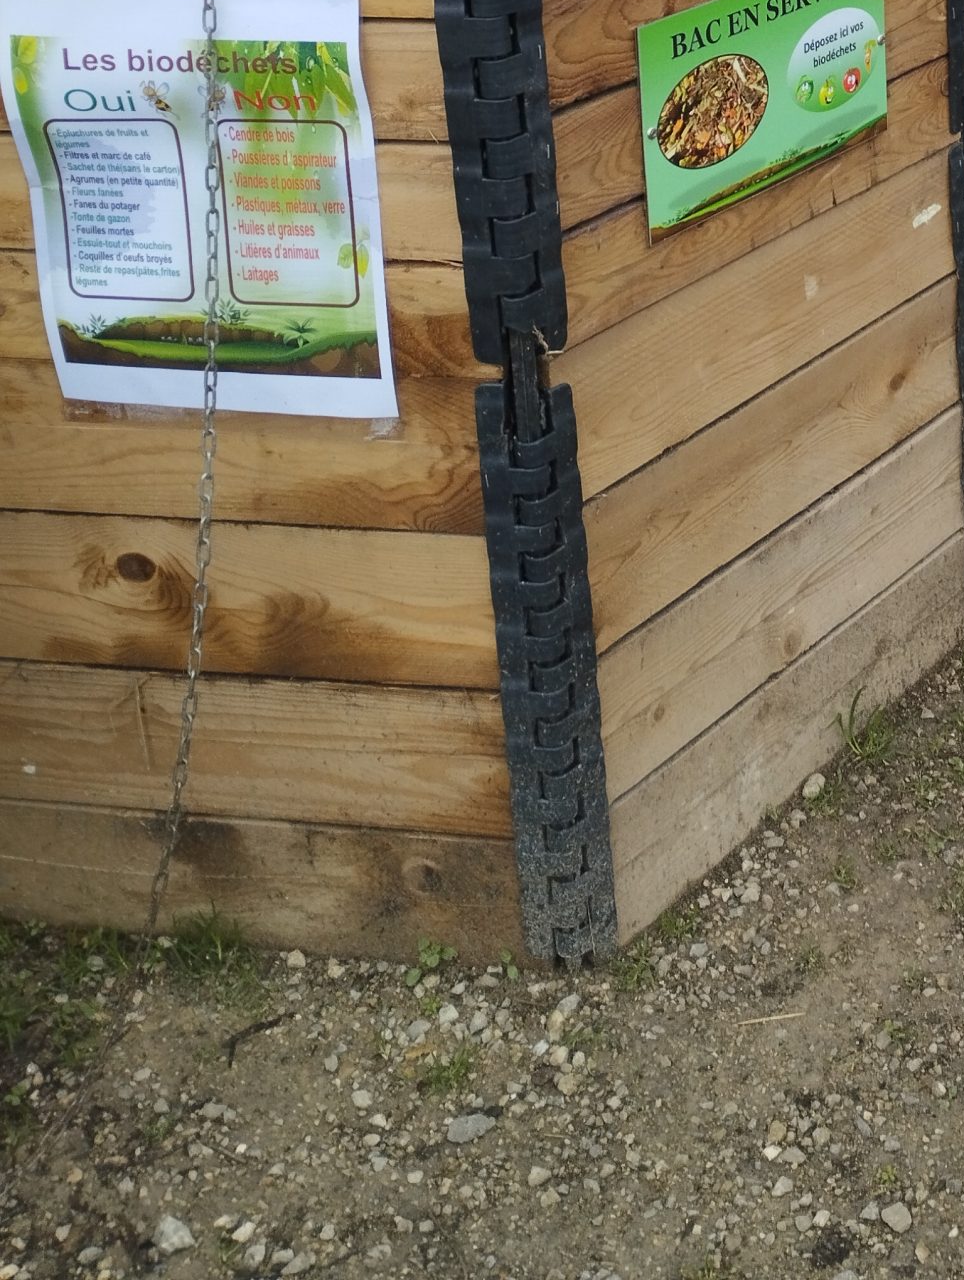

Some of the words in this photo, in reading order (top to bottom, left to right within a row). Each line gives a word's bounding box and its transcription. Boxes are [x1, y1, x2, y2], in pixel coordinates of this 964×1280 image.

[671, 18, 722, 59] BAC
[727, 4, 760, 37] EN
[803, 31, 838, 54] Déposez
[840, 26, 848, 38] ici
[849, 20, 864, 35] vos
[62, 47, 116, 71] Les
[128, 49, 297, 75] biodéchets
[813, 42, 856, 68] biodéchets
[64, 88, 137, 112] Oui
[232, 89, 316, 111] Non
[106, 129, 115, 137] de
[117, 129, 138, 137] fruits
[229, 126, 260, 141] Cendre
[263, 128, 274, 142] de
[276, 128, 295, 143] bois
[64, 151, 89, 159] Filtres
[123, 152, 132, 160] de
[135, 152, 151, 160] café
[70, 175, 105, 185] Agrumes
[121, 176, 142, 186] petite
[234, 172, 268, 188] Viandes
[271, 175, 279, 189] et
[282, 177, 320, 193] poissons
[72, 187, 96, 196] Fleurs
[73, 199, 96, 209] Fanes
[99, 199, 109, 209] du
[111, 201, 140, 211] potager
[323, 204, 345, 214] verre
[96, 213, 105, 222] de
[108, 215, 131, 224] gazon
[76, 225, 106, 234] Feuilles
[108, 228, 135, 236] mortes
[238, 219, 265, 235] Huiles
[268, 222, 276, 235] et
[278, 221, 315, 239] graisses
[132, 241, 173, 250] mouchoirs
[240, 243, 272, 258] Litières
[275, 243, 320, 260] d'animaux
[78, 251, 114, 262] Coquilles
[242, 266, 279, 285] Laitages
